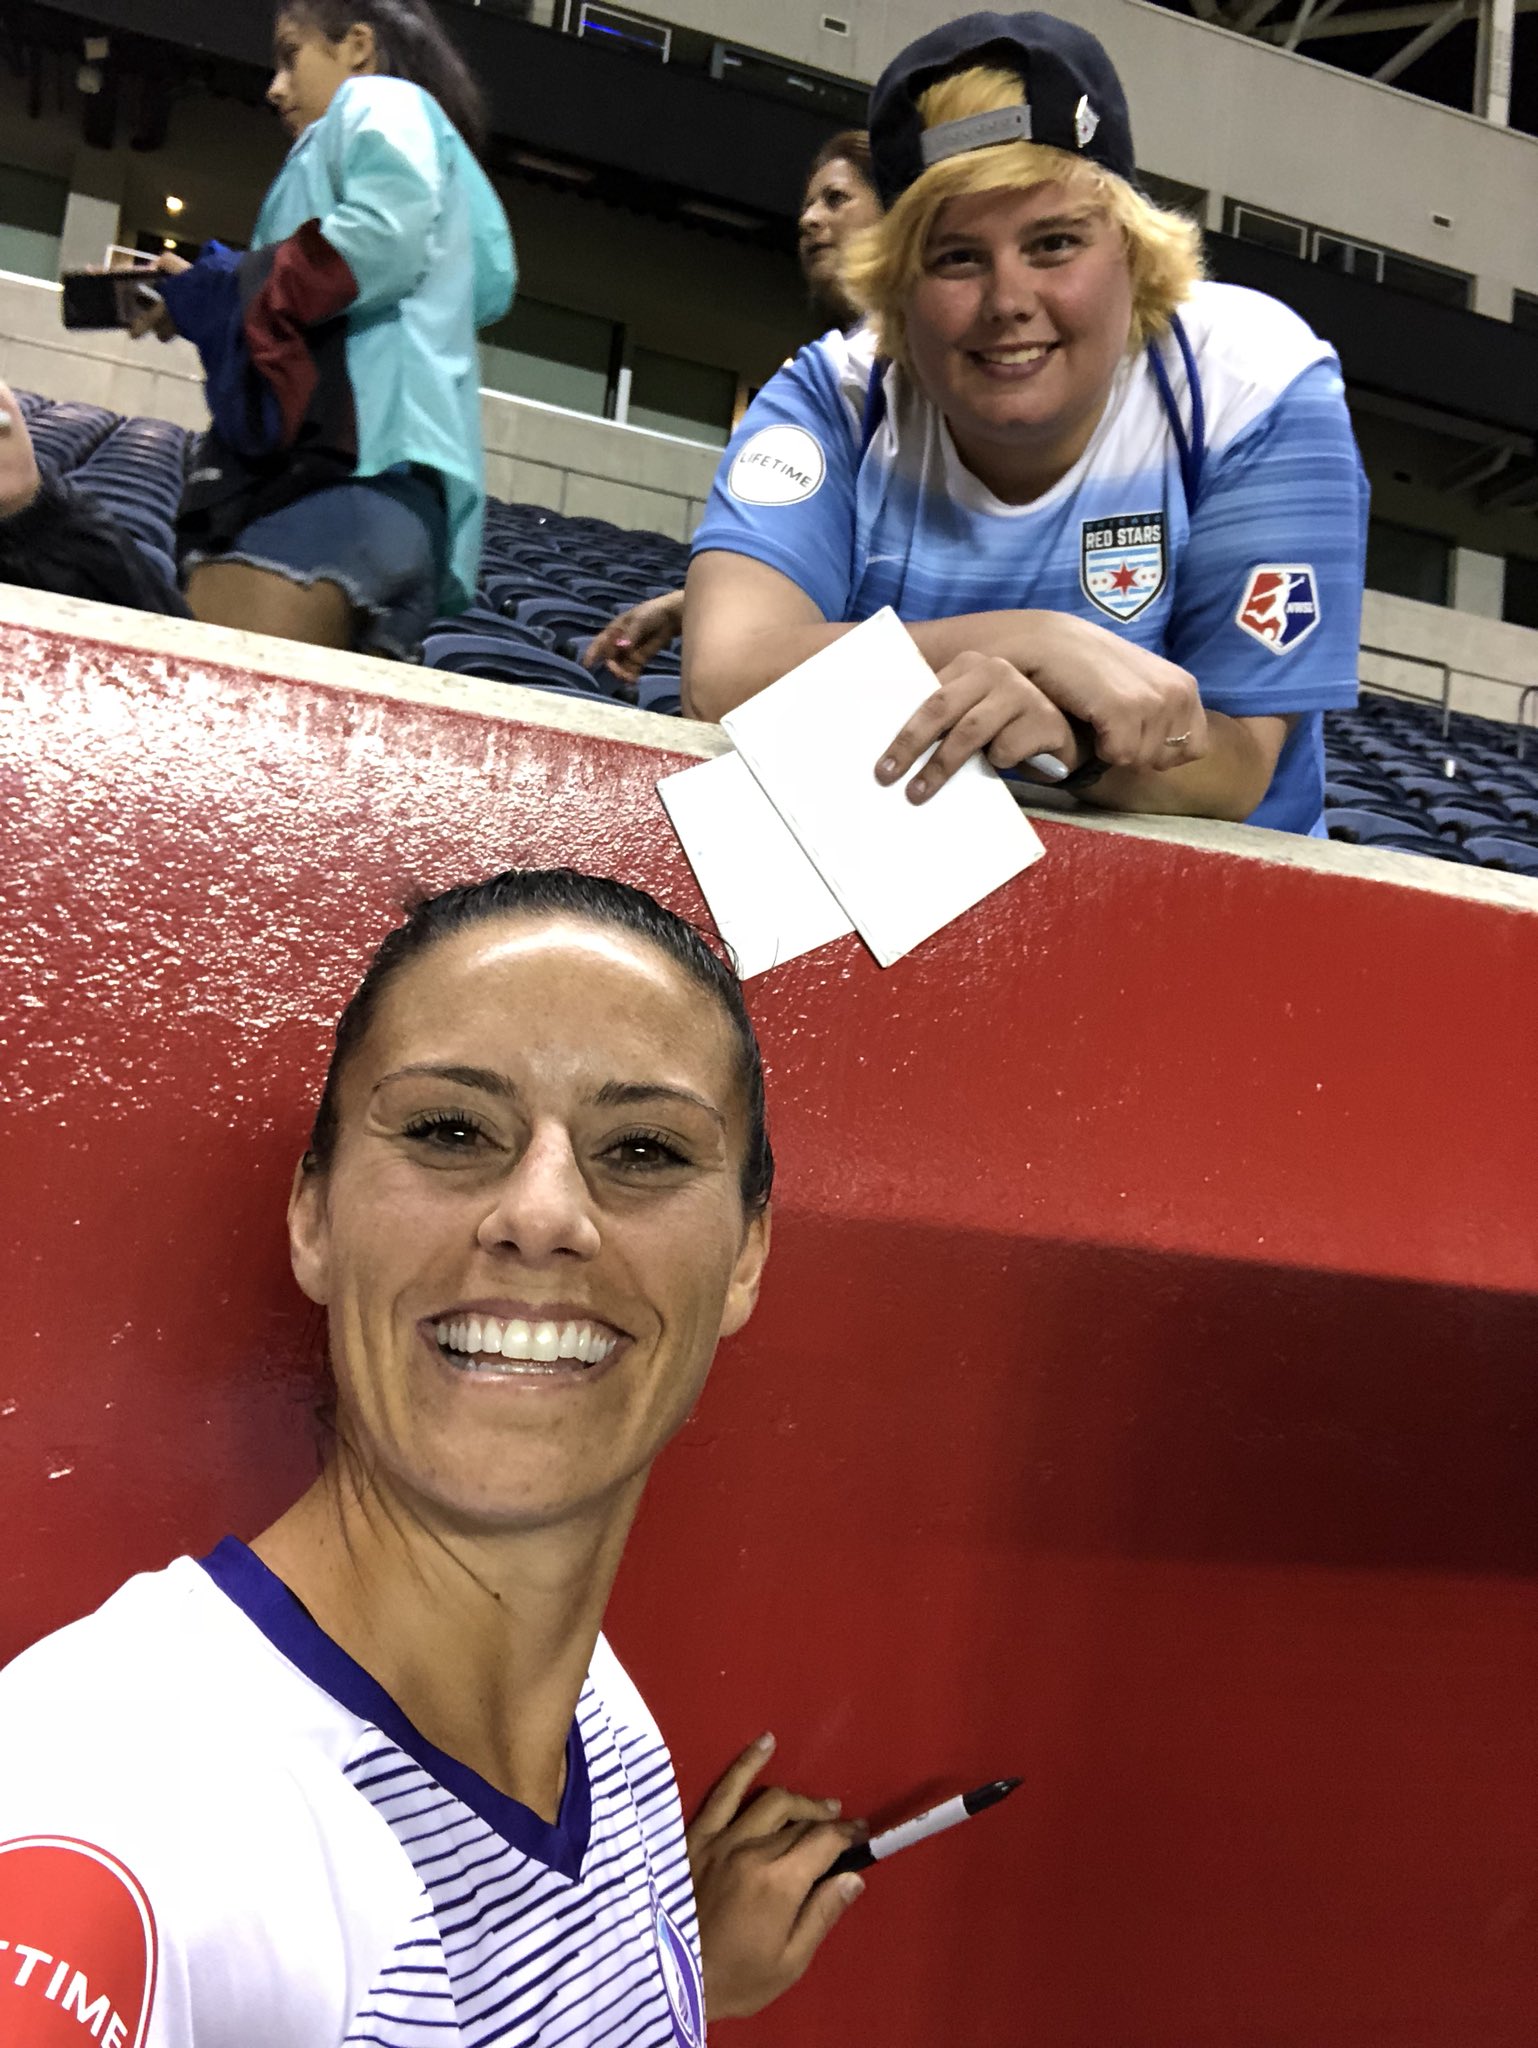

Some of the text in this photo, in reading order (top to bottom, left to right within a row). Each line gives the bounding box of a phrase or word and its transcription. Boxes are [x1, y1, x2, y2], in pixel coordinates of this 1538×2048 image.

[740, 453, 812, 488] LIFETIME
[1085, 525, 1162, 550] RED STARS
[0, 1940, 128, 2048] TIME
